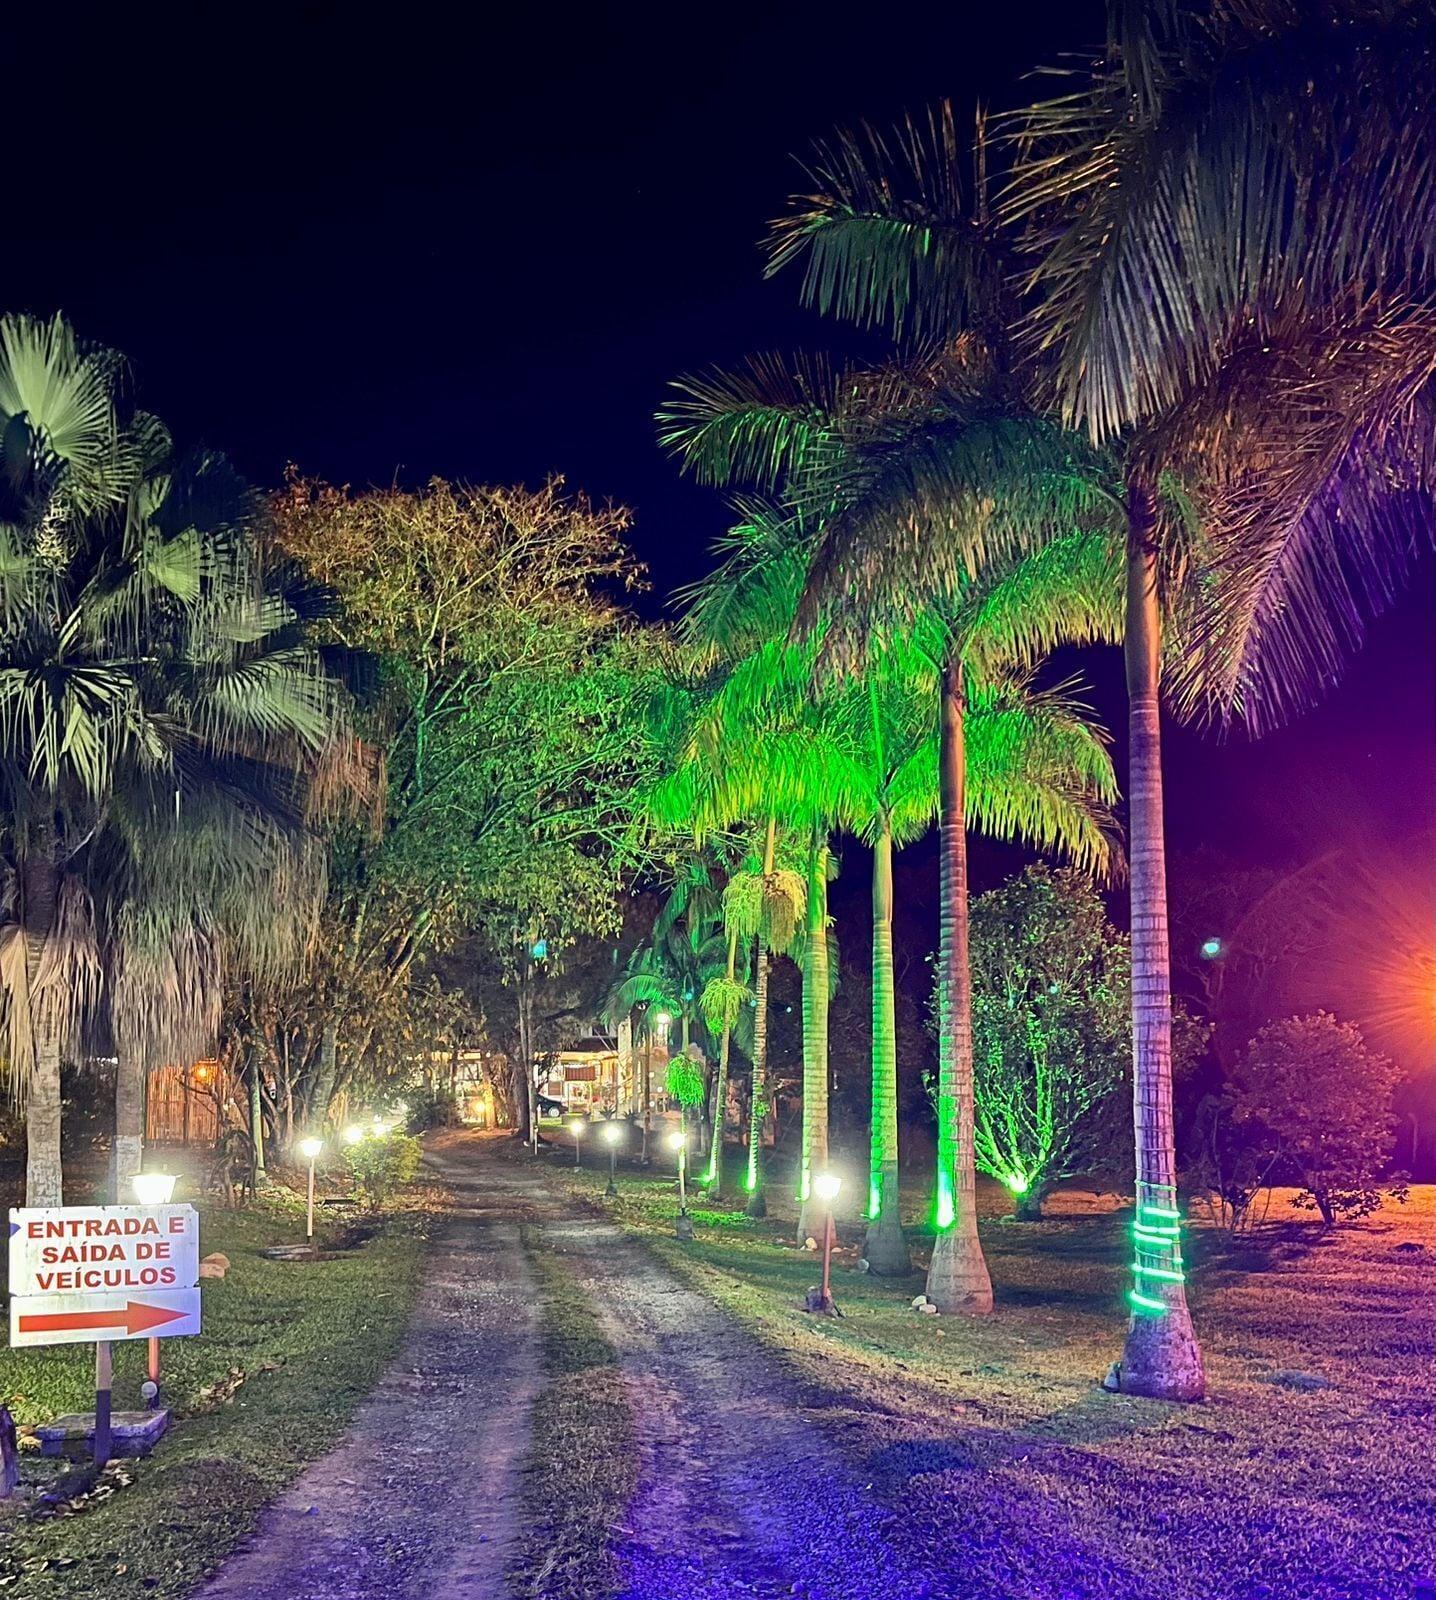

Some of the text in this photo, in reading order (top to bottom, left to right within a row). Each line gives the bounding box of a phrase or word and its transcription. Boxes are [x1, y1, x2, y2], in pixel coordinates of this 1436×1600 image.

[28, 1217, 184, 1238] ENTRADA E
[42, 1241, 170, 1263] SAÍDA DE
[36, 1267, 176, 1290] VEÍCULOS
